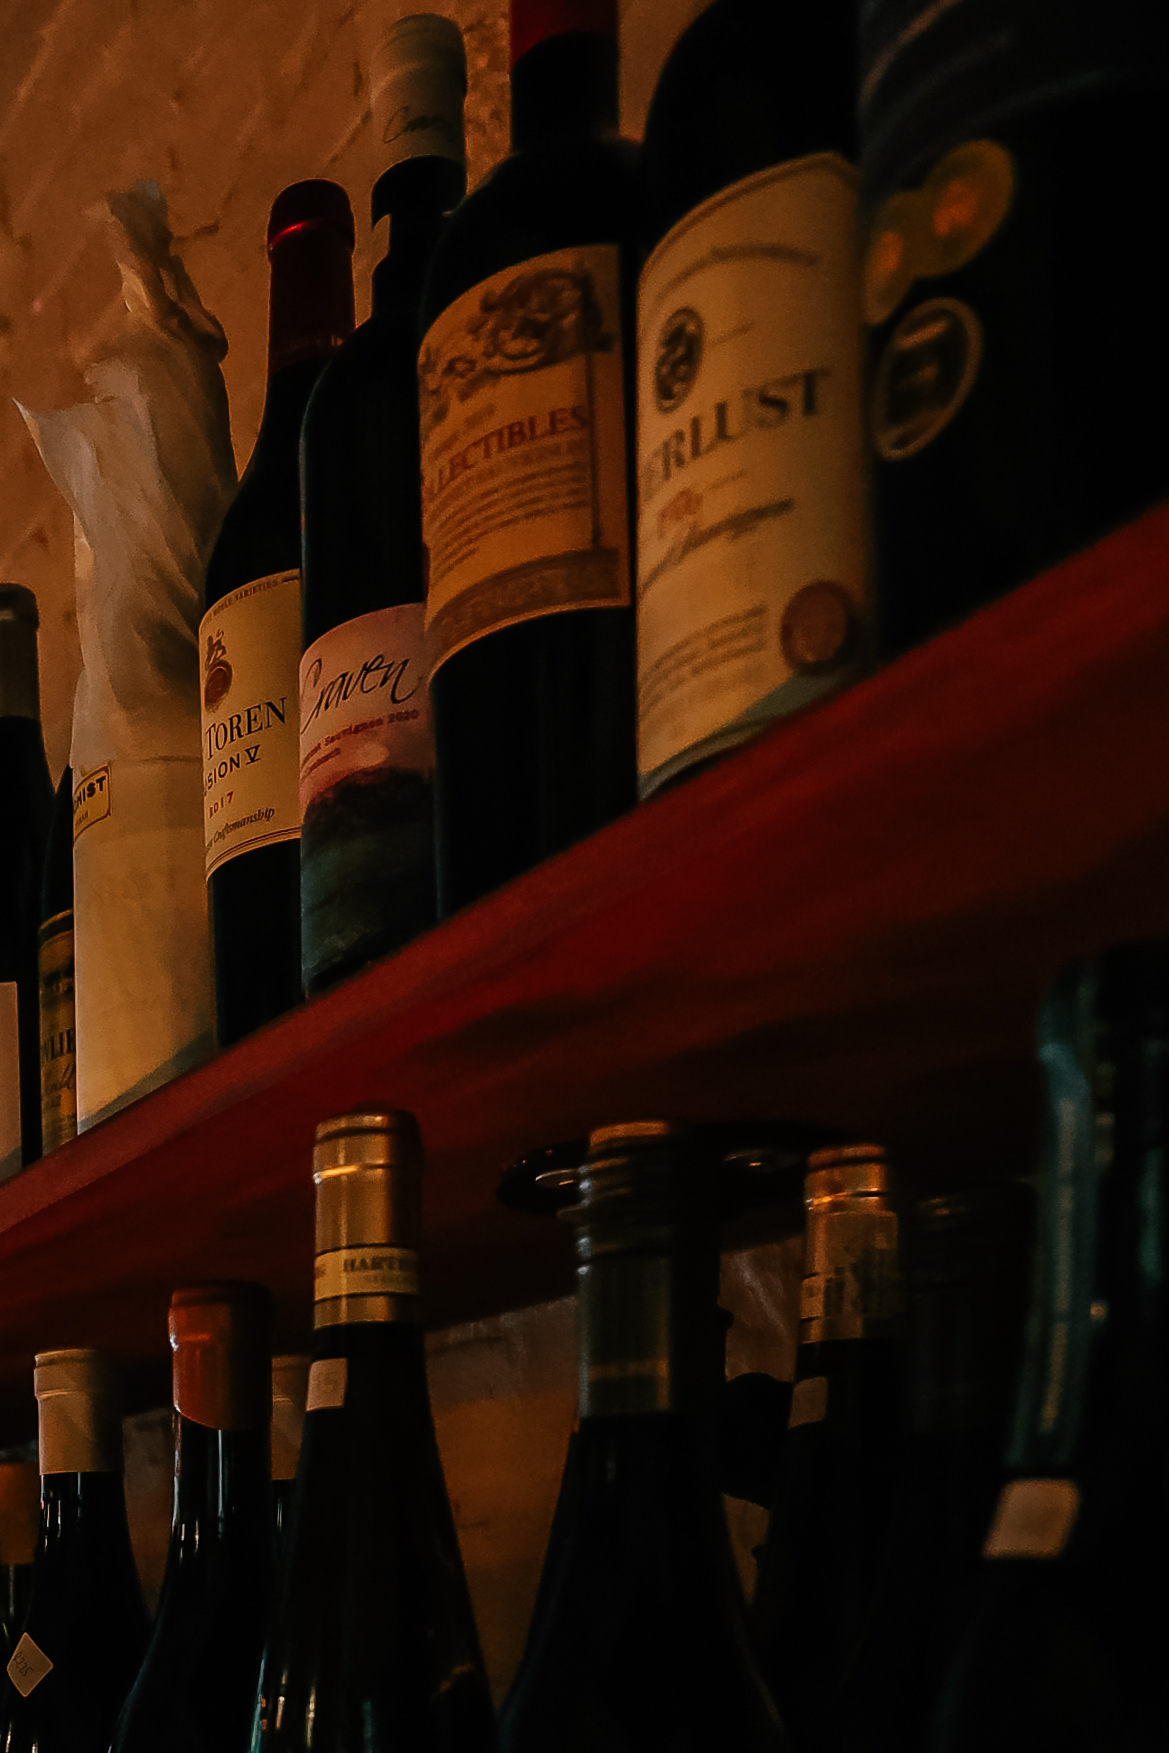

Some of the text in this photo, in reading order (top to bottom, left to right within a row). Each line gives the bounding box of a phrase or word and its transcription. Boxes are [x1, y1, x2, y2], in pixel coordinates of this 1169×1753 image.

[300, 654, 422, 735] Craven
[206, 697, 287, 760] TOREN
[204, 752, 240, 797] SION
